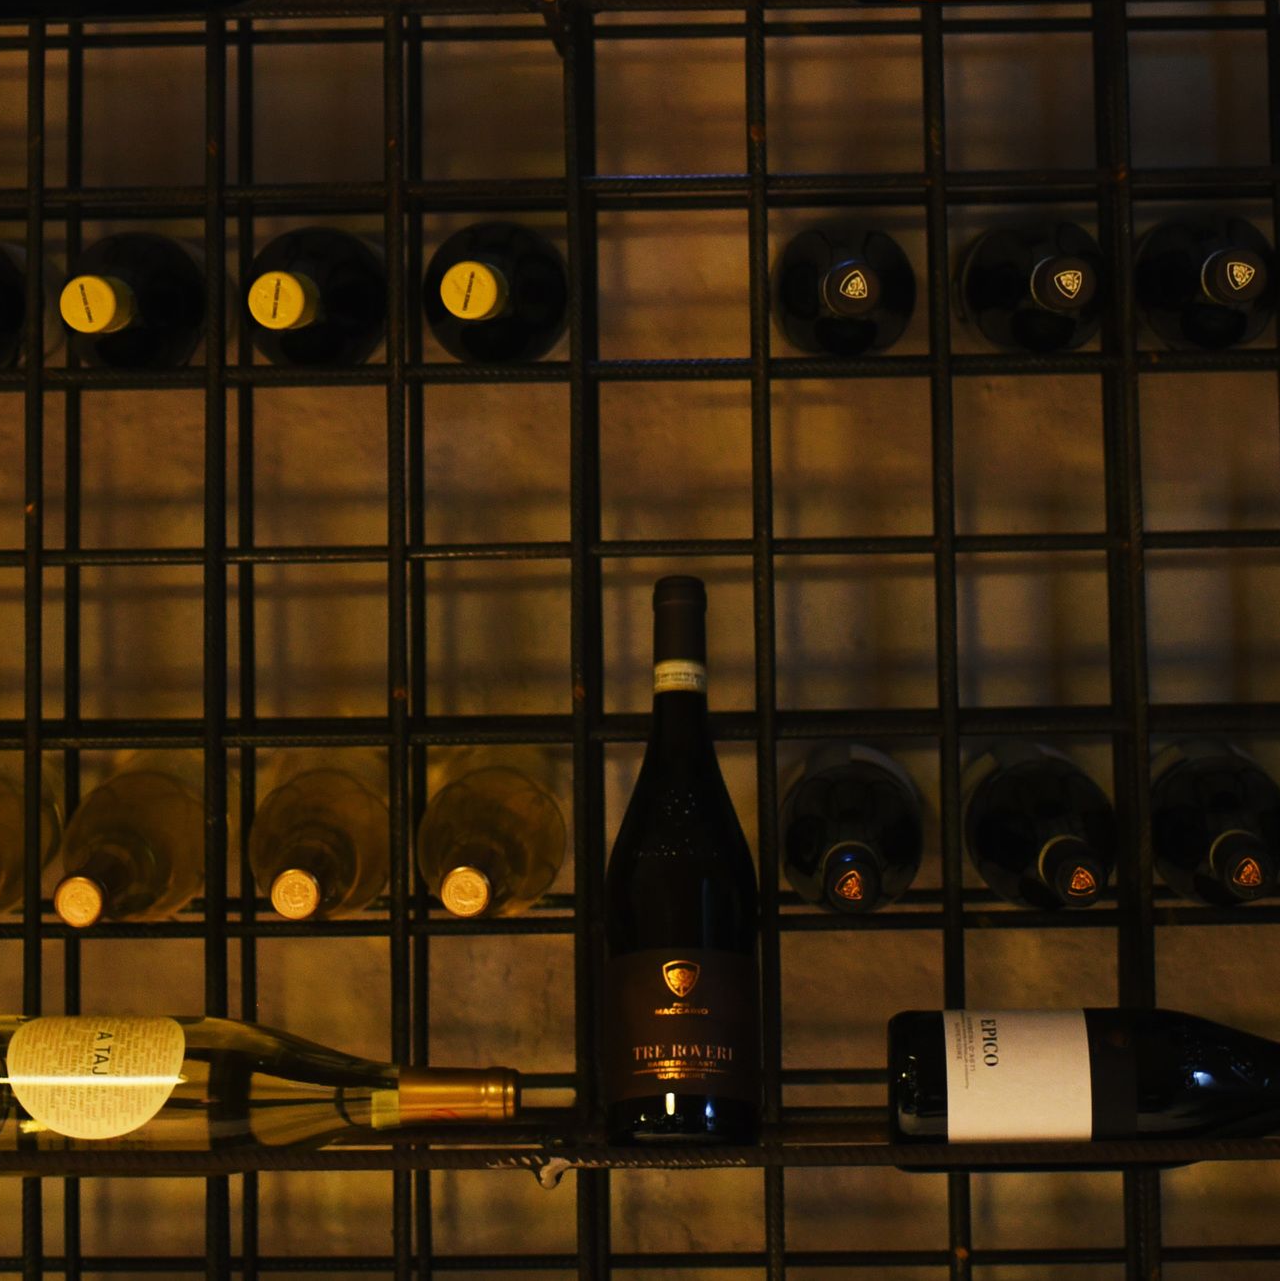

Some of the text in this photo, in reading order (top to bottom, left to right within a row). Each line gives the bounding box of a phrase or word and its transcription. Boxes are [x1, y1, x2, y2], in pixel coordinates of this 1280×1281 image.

[96, 1031, 114, 1041] A
[980, 1018, 999, 1067] EPICO
[632, 1043, 736, 1063] TRE ROVERI
